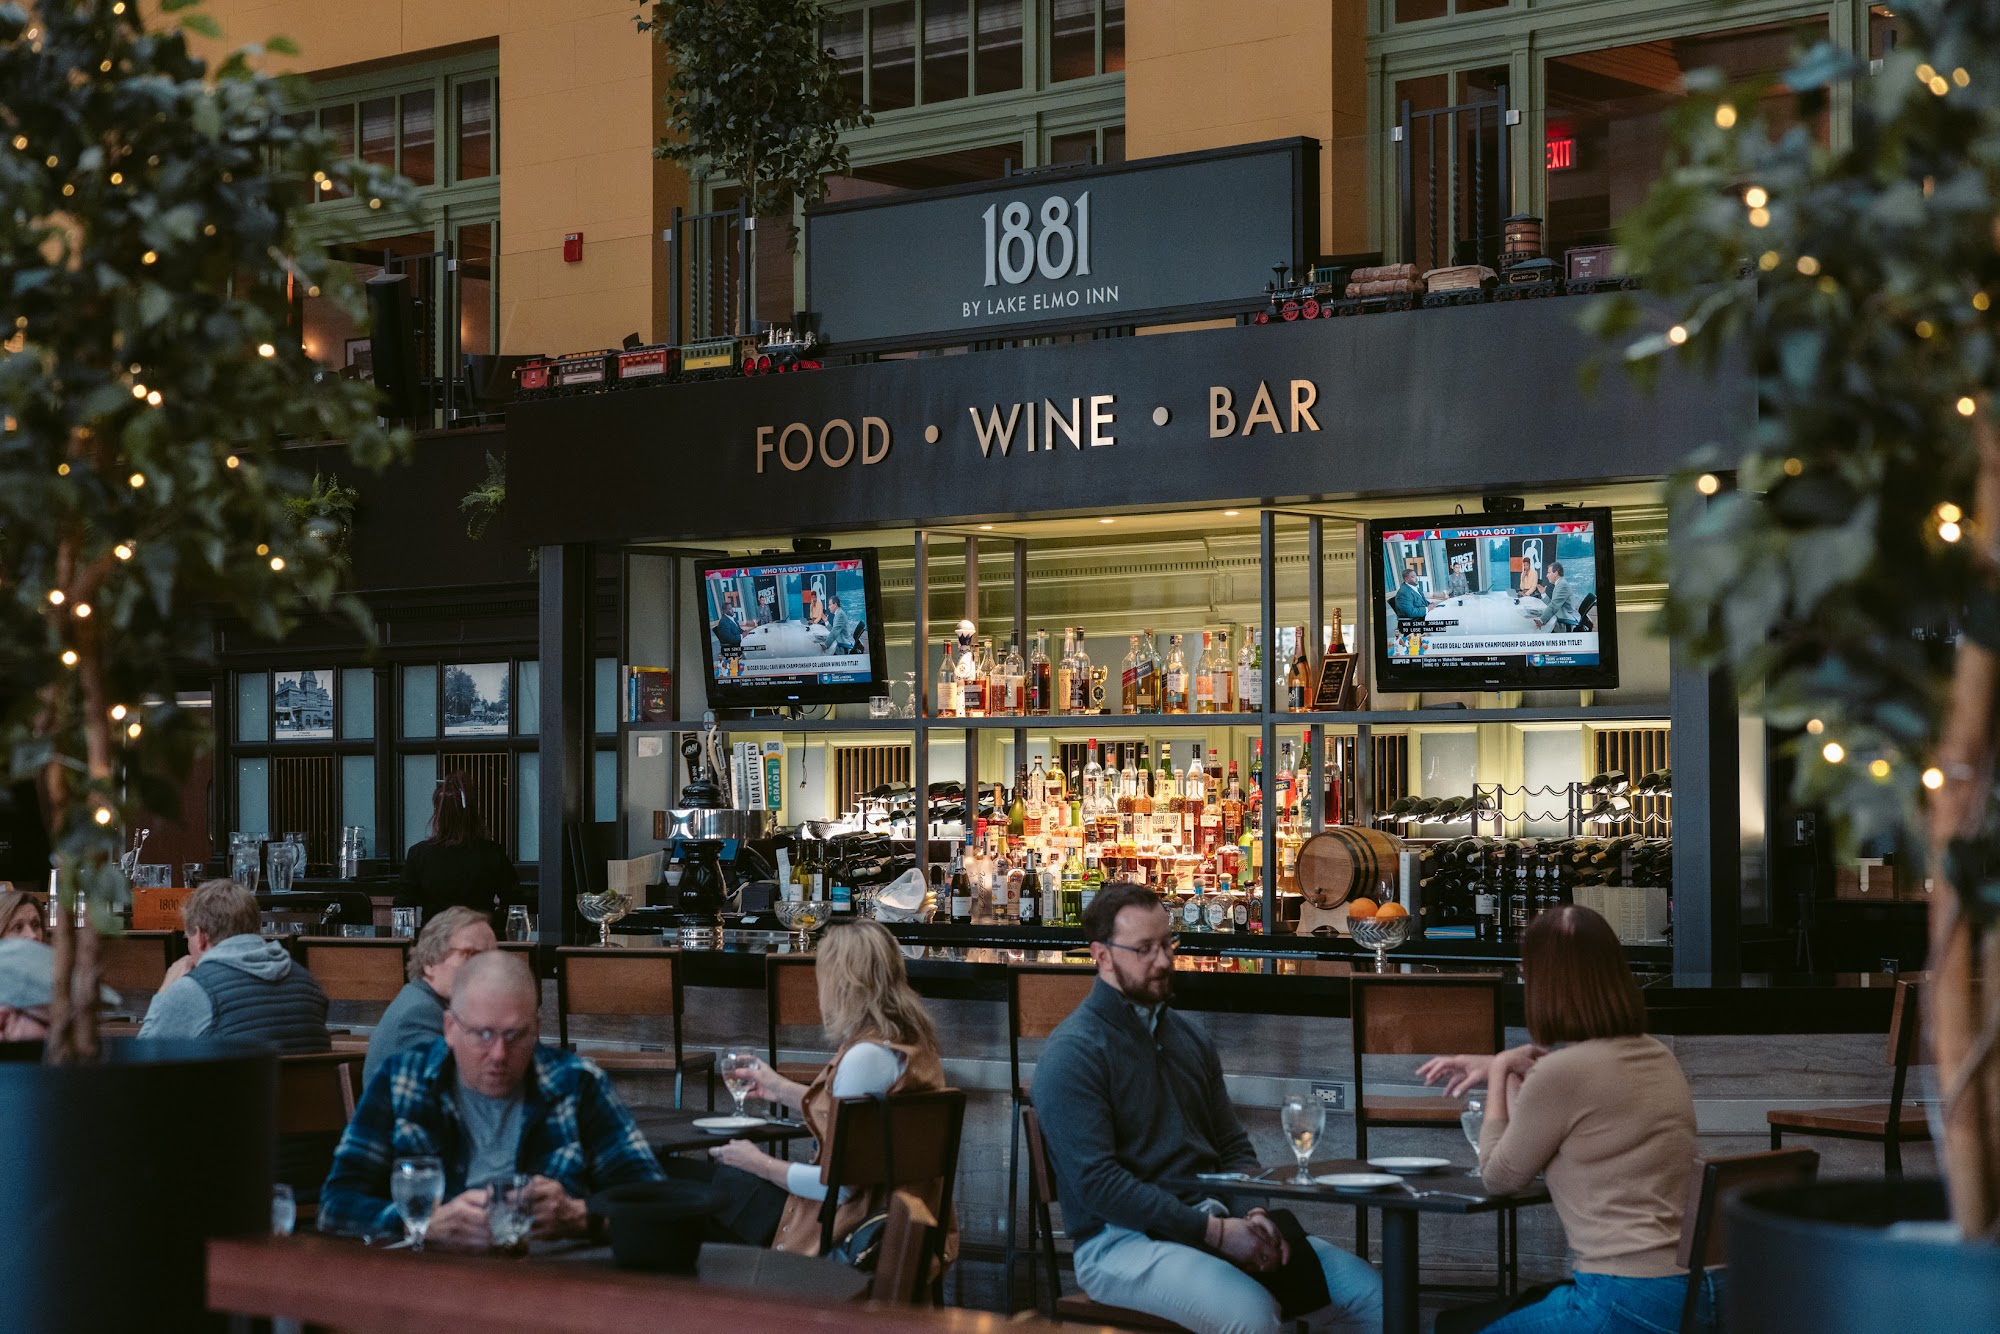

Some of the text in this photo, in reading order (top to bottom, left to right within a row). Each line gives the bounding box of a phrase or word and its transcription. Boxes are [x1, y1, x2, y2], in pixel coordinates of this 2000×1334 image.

[1546, 140, 1571, 169] EXIT
[981, 191, 1091, 287] 1881
[963, 285, 1119, 317] BY LAKE ELMO INN
[756, 379, 1322, 474] FOOD WINE BAR
[1457, 528, 1516, 537] WHO YA GOT?
[1450, 551, 1474, 566] FIRST
[772, 768, 781, 802] GRADE
